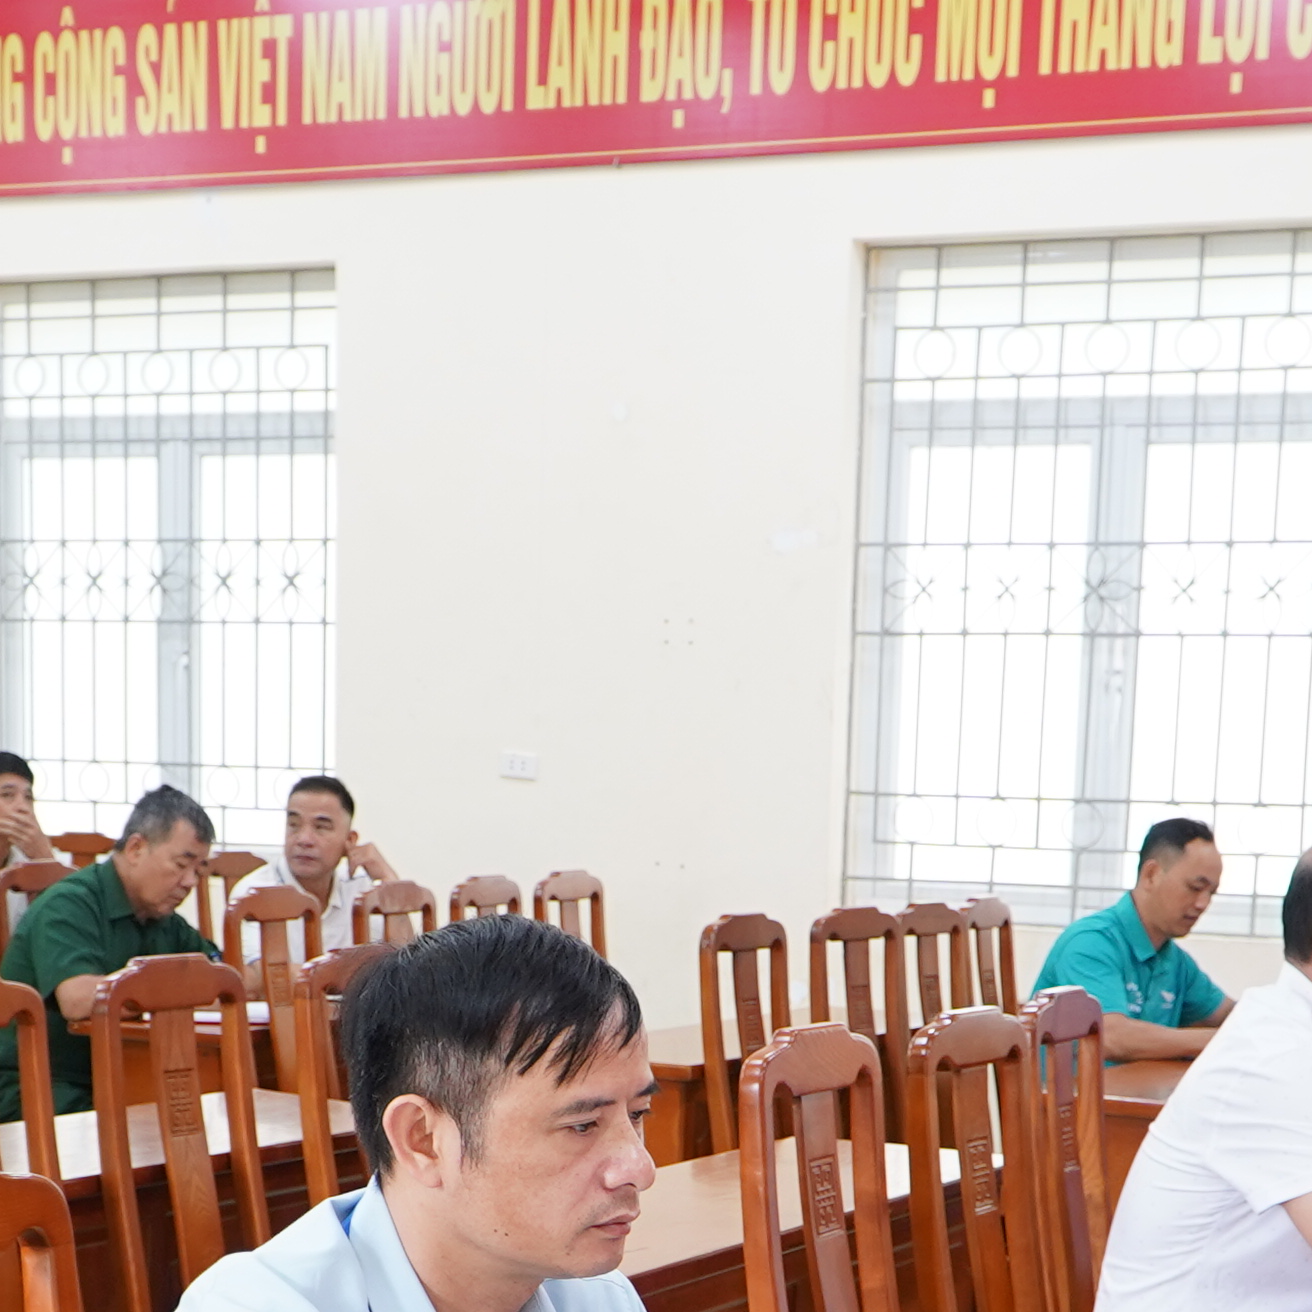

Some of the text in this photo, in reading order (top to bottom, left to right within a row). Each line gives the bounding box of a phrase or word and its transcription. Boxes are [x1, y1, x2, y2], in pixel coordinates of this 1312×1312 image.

[33, 4, 127, 166] CỘNG
[216, 0, 294, 155] VIỆT
[301, 5, 389, 125] NAM
